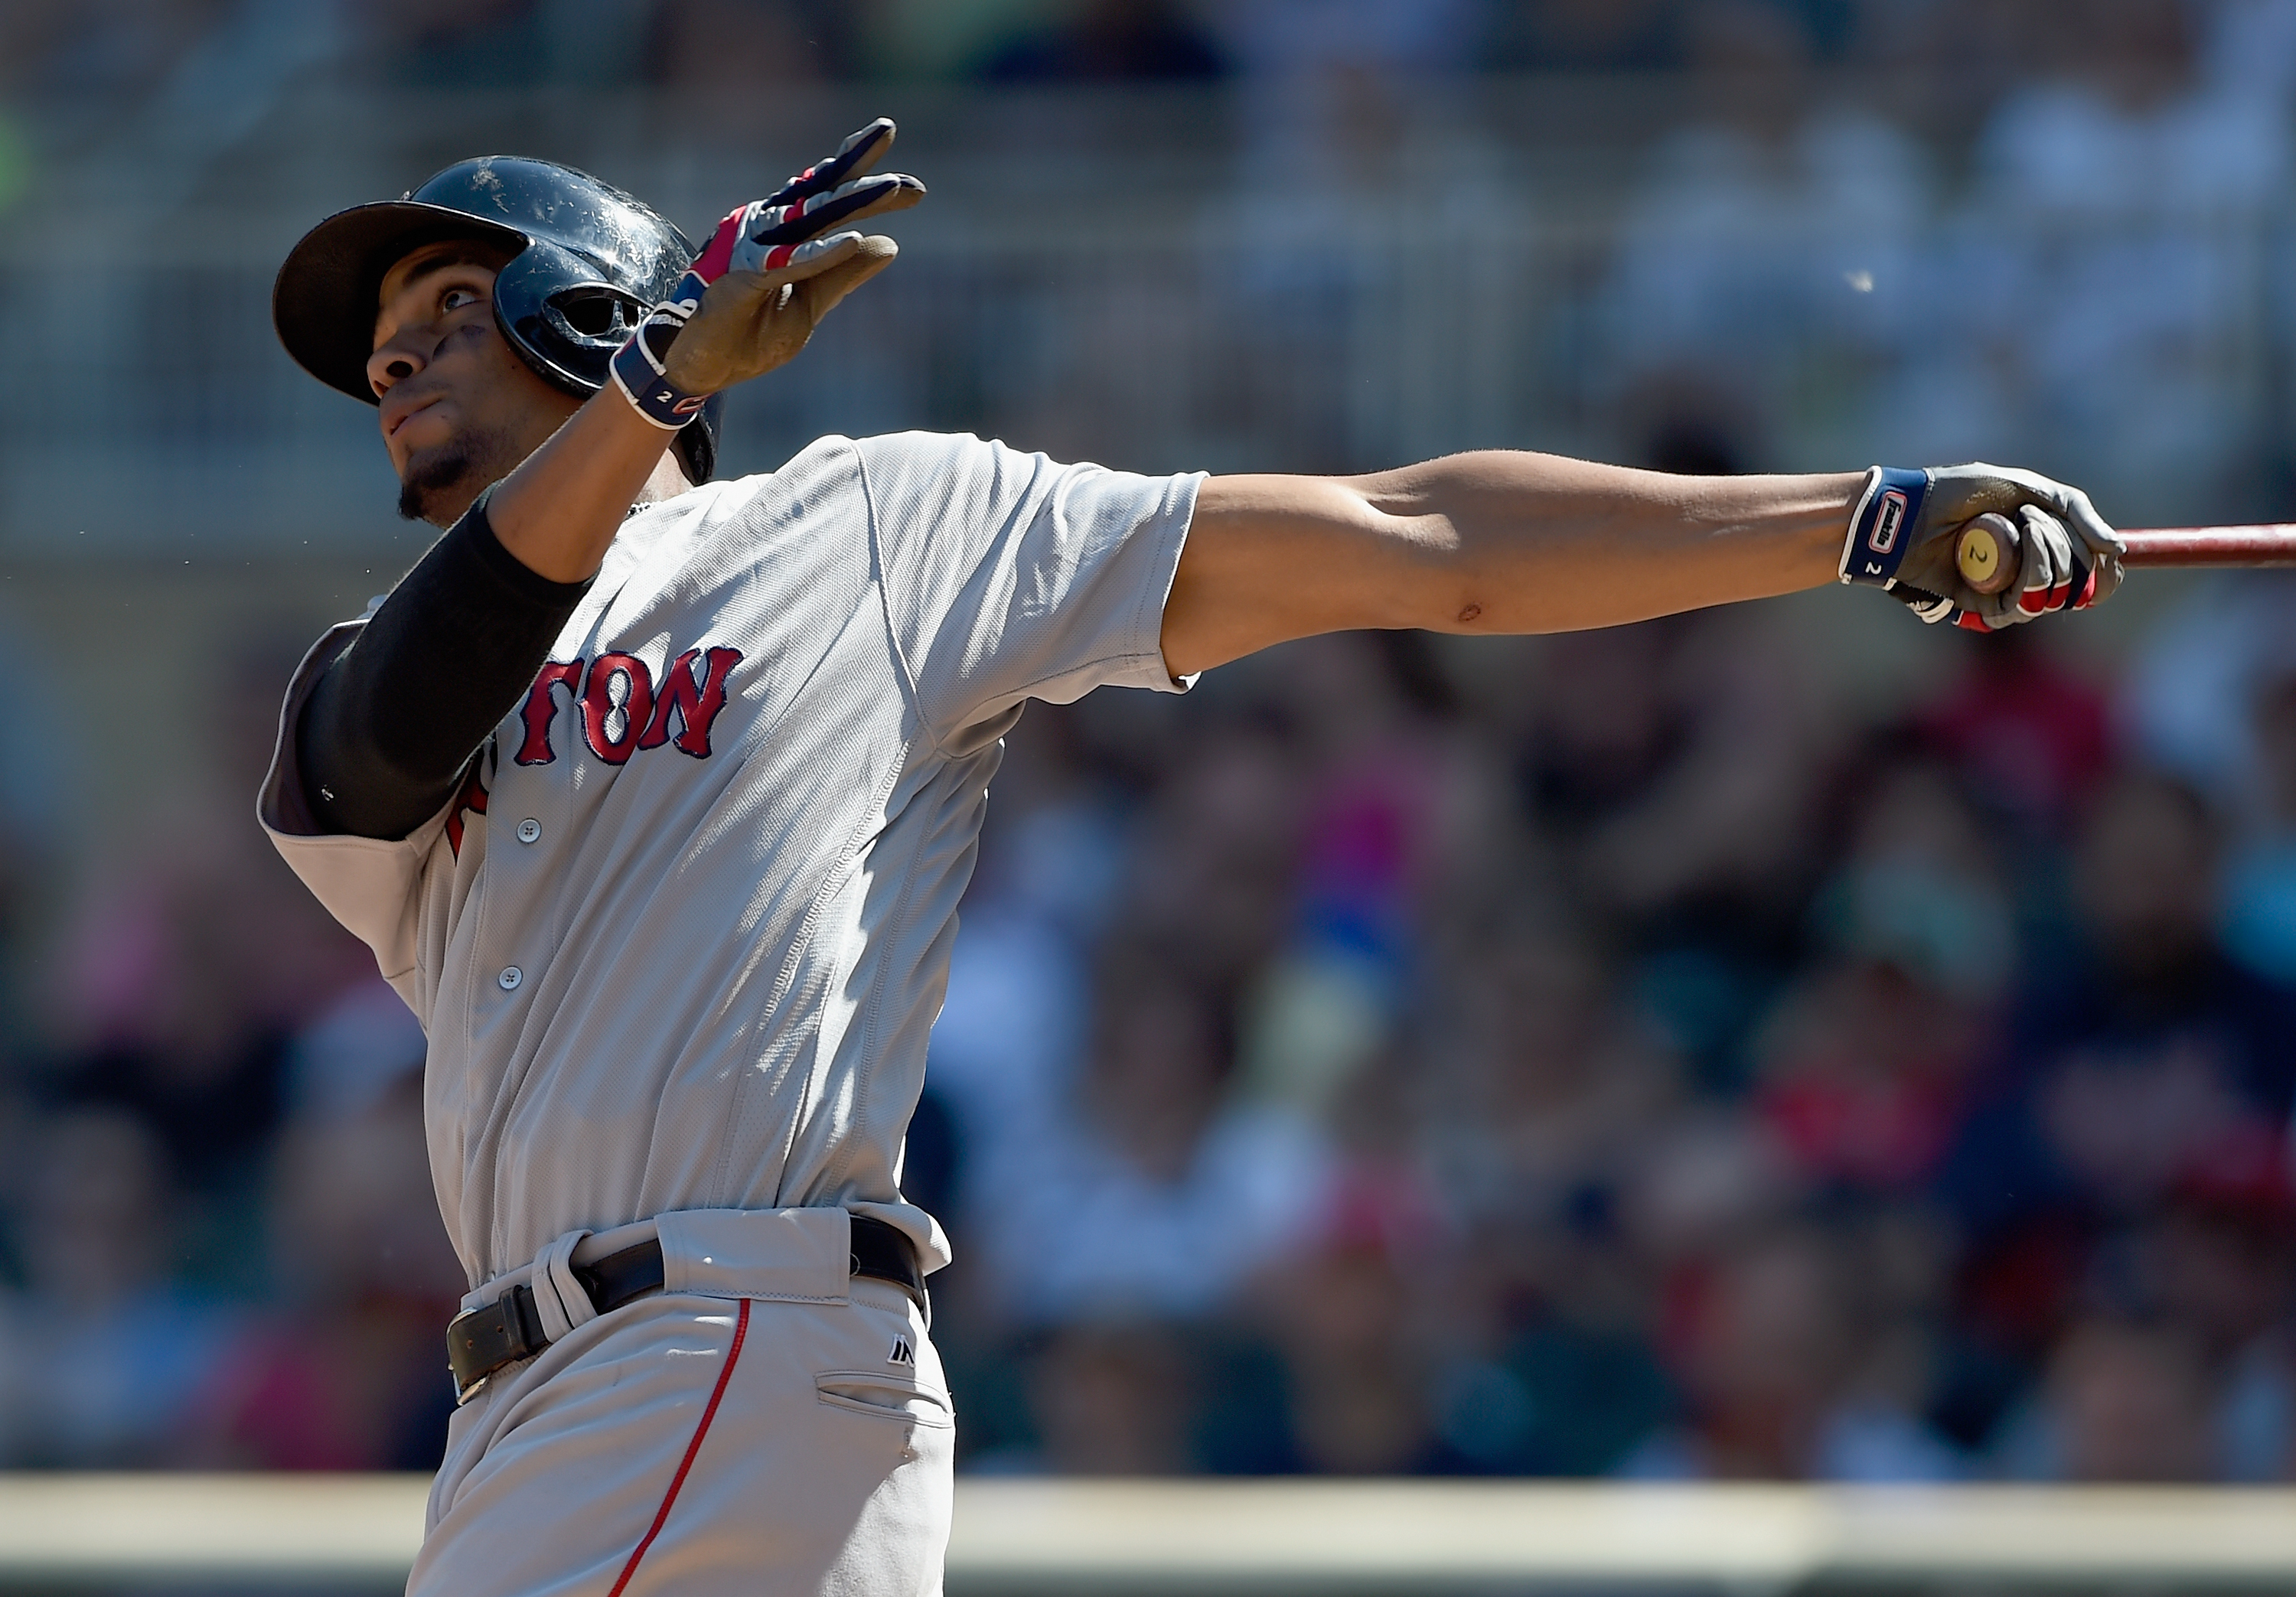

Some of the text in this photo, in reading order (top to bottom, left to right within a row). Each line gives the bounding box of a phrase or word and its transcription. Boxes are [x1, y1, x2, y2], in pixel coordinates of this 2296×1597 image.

[656, 390, 673, 403] 2
[1968, 544, 1988, 563] 2
[1865, 561, 1883, 575] 2
